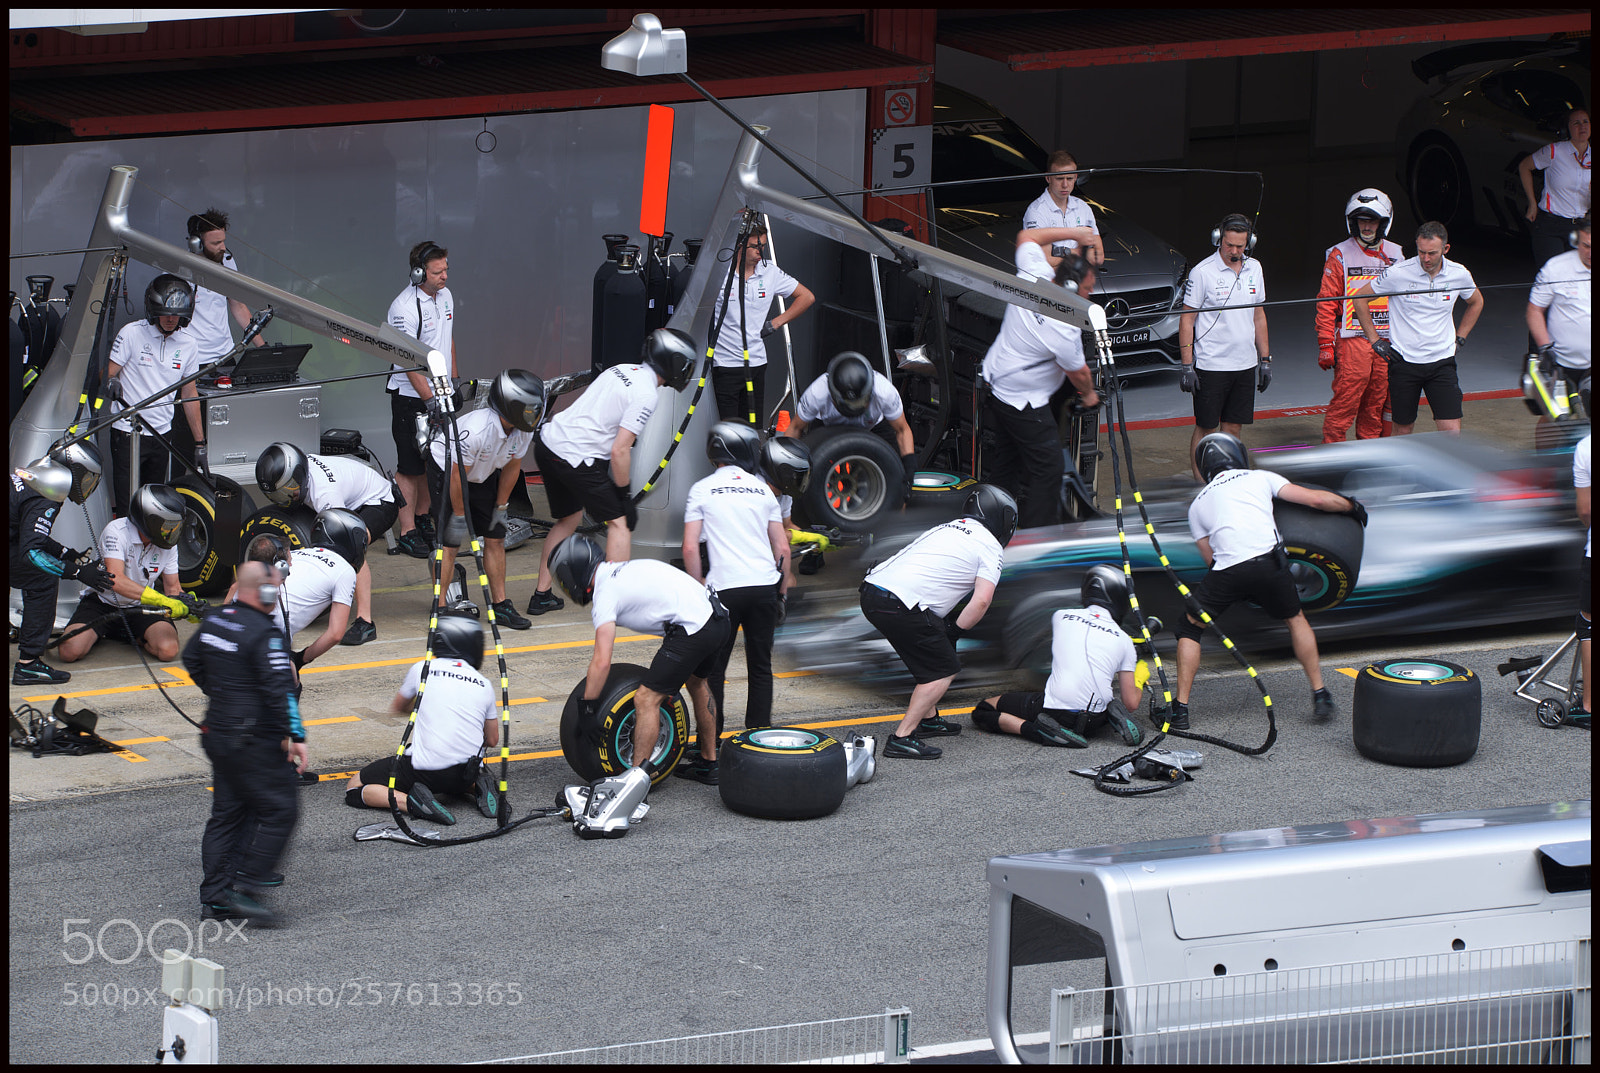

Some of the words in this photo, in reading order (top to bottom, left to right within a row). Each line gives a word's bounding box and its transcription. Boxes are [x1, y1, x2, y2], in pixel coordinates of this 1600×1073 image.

[892, 143, 915, 179] 5
[1109, 336, 1131, 344] DICAL
[1133, 333, 1148, 342] CAR
[710, 486, 765, 496] PETRONAS
[258, 516, 302, 546] ZERO
[1062, 613, 1120, 637] PETRONAS
